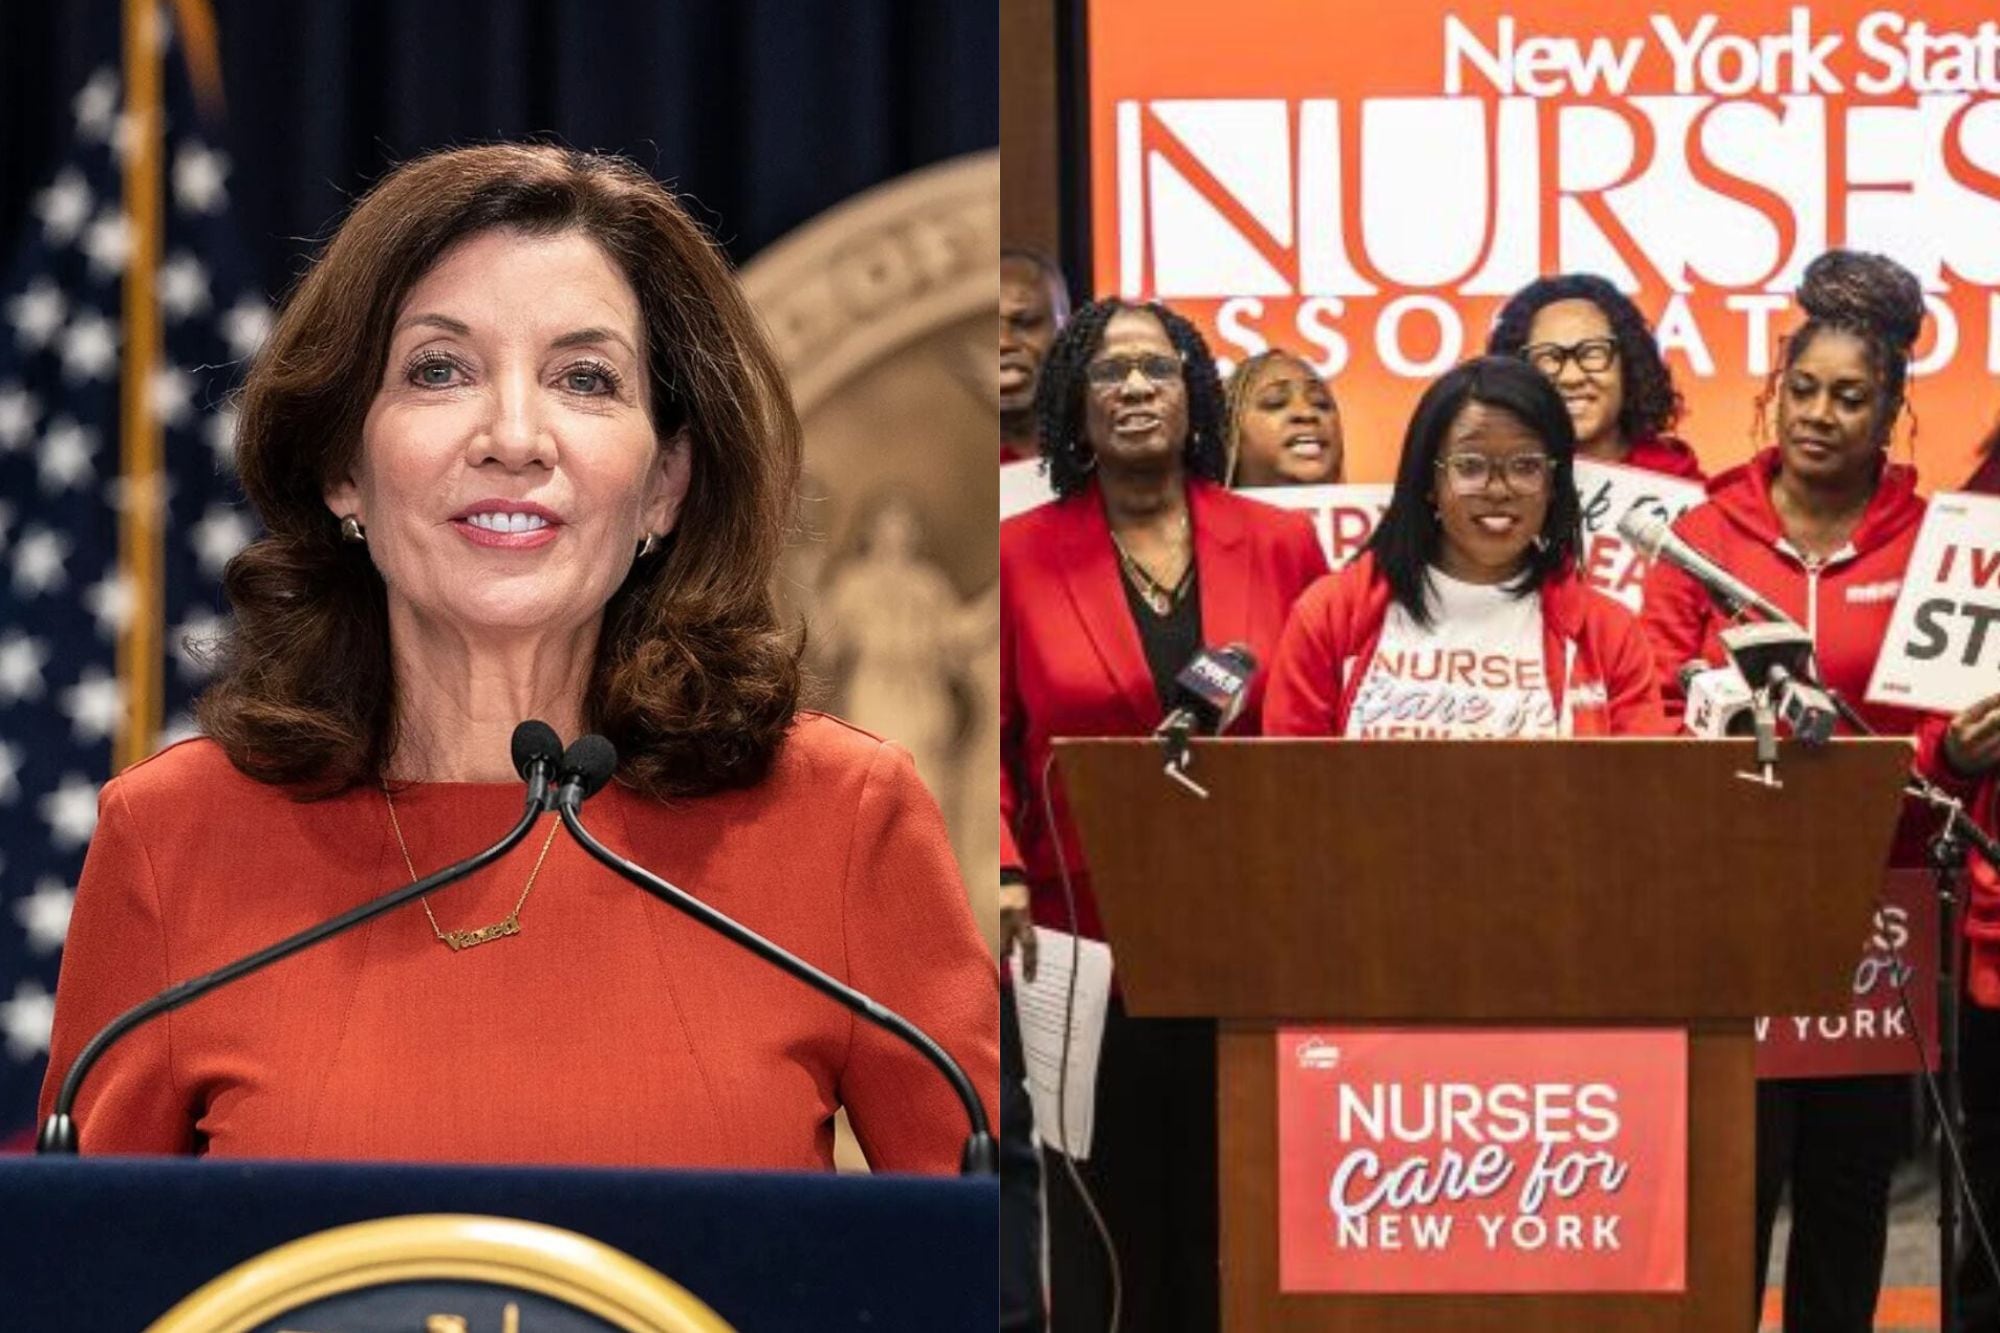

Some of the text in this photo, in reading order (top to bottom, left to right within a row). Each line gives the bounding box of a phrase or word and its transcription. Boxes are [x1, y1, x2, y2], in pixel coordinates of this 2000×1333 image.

[1444, 14, 1645, 97] New
[1649, 6, 1845, 95] York
[1338, 1083, 1621, 1143] NURSES
[1329, 1138, 1629, 1218] Care for
[1336, 1213, 1623, 1251] NEW YORK
